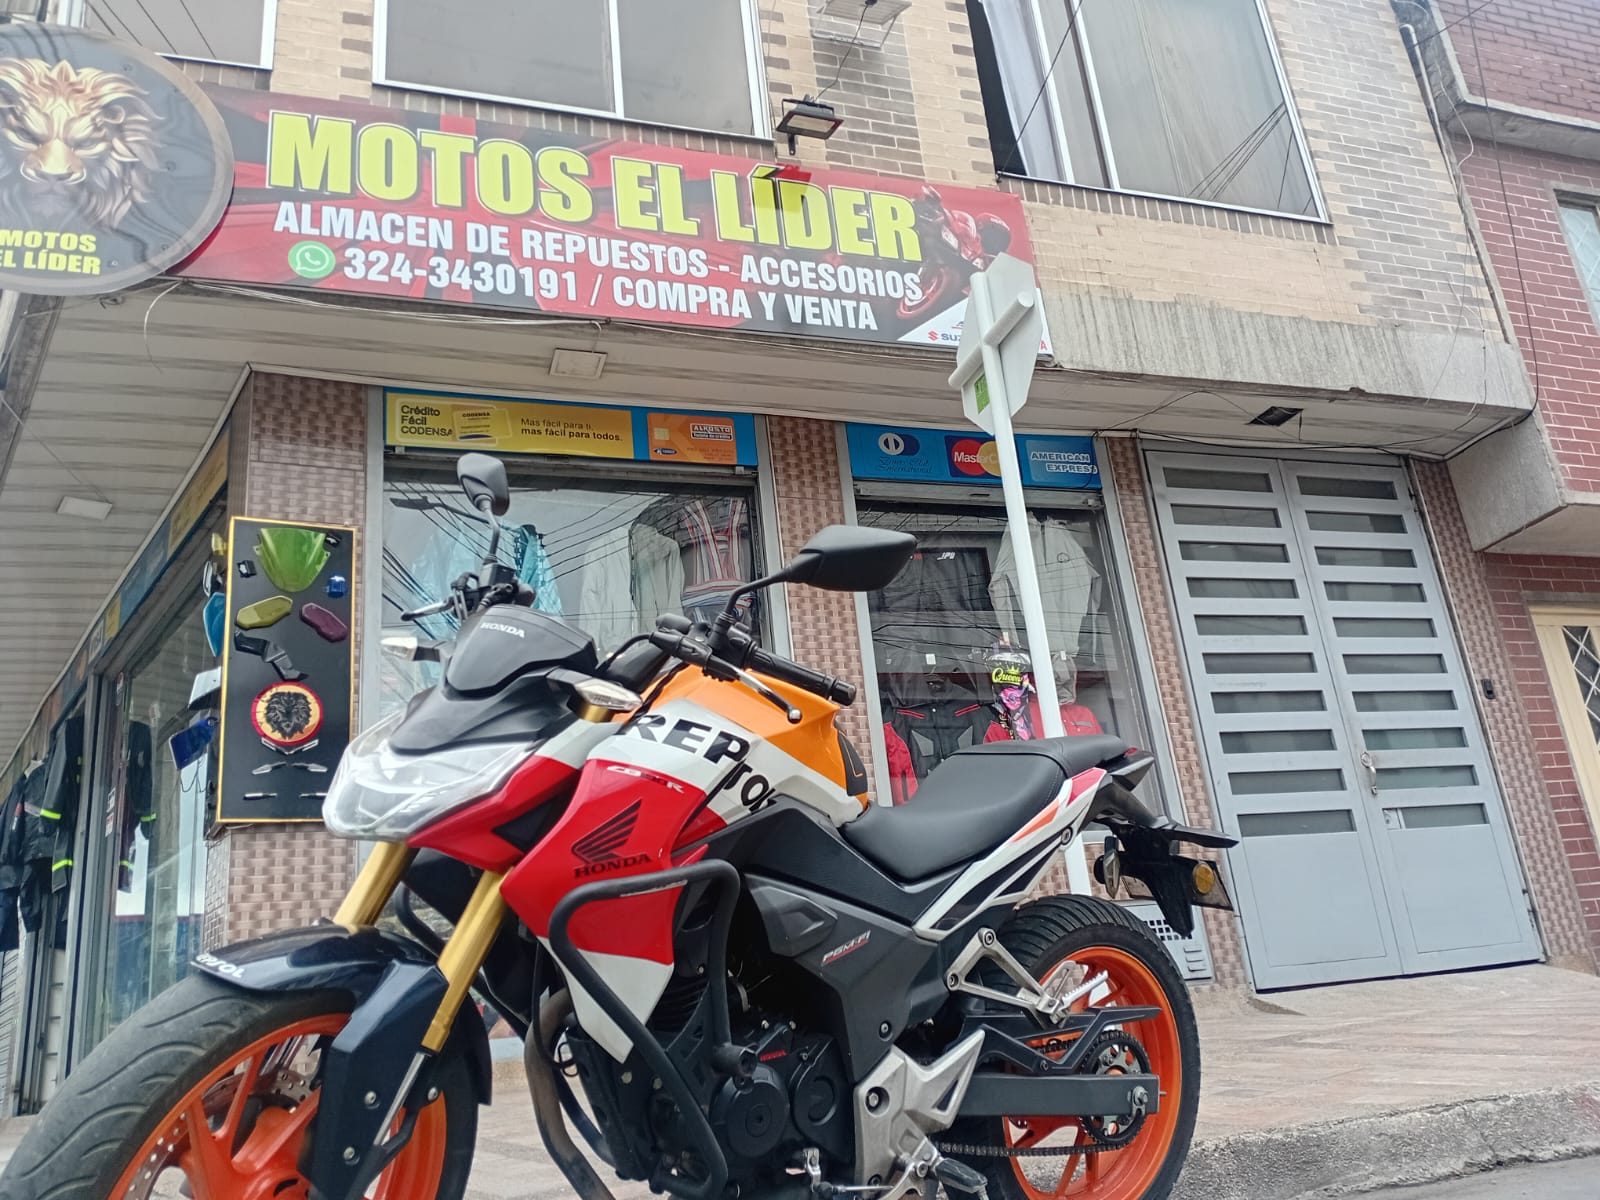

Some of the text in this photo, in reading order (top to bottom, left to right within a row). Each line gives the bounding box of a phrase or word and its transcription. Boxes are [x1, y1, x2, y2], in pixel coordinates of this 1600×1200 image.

[266, 110, 923, 262] MOTOS EL LÍDER
[0, 229, 97, 253] MOTOS
[274, 201, 453, 250] ALMACEN
[467, 222, 510, 257] DE
[522, 227, 709, 278] REPUESTOS
[740, 255, 923, 301] ACCESORIOS
[0, 249, 101, 275] L LÍDER
[343, 247, 878, 331] 324-3430191 / COMPRA Y VENTA
[401, 405, 440, 416] Crédito
[401, 415, 427, 426] Fácil
[521, 417, 540, 427] Mas
[563, 422, 584, 431] para
[401, 426, 453, 437] CODENSA
[521, 427, 624, 442] mas fácil para todos.
[693, 425, 731, 433] ALKOSTO
[953, 451, 1001, 465] MasterC
[1031, 452, 1090, 463] AMERICAN
[1046, 463, 1098, 474] EXPRESS
[480, 622, 525, 638] HONDA
[574, 854, 651, 878] HONDA
